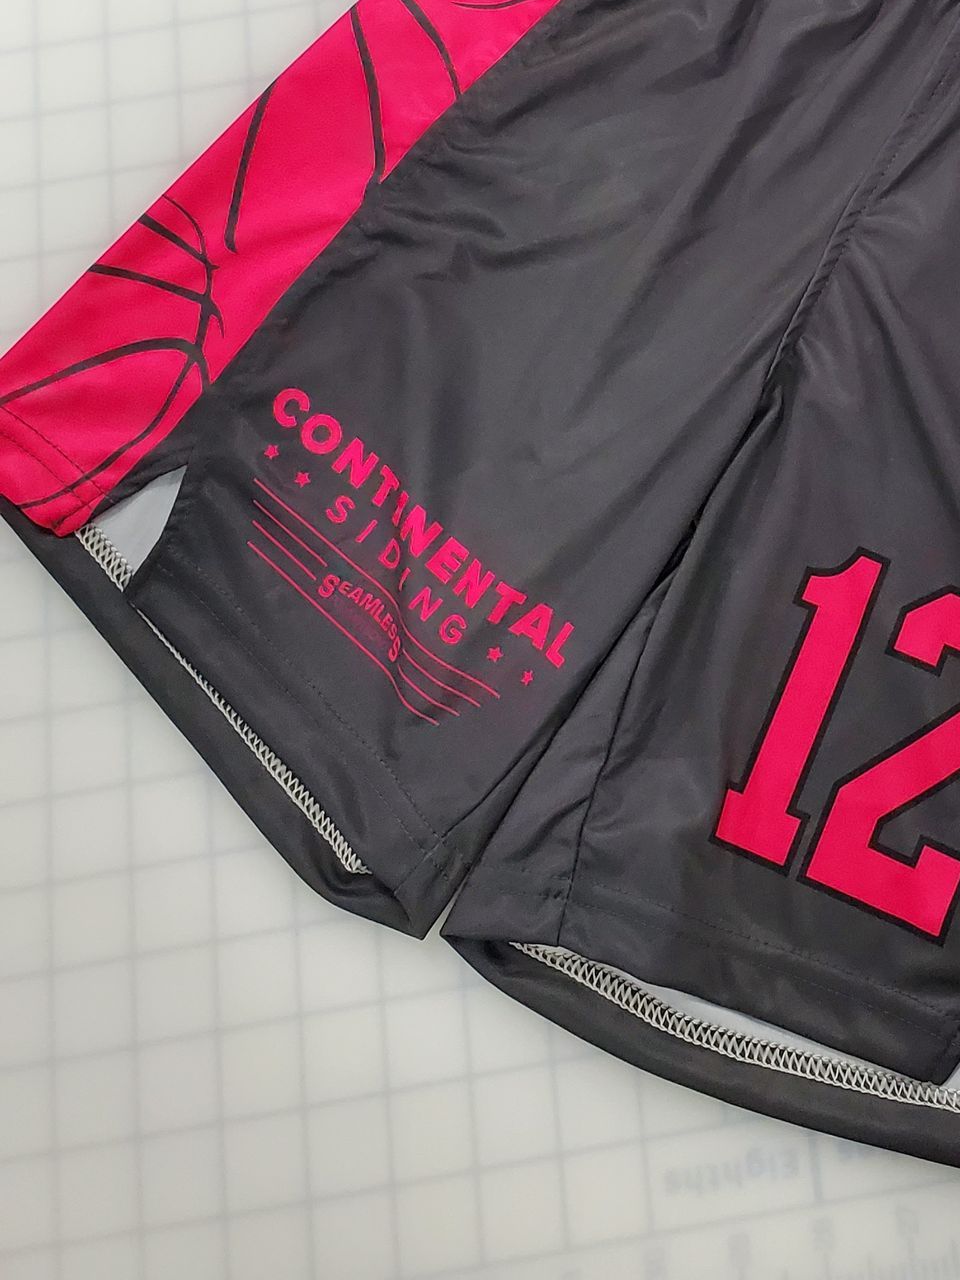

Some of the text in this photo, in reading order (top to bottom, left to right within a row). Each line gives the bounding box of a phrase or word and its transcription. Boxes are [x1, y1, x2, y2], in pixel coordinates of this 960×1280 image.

[272, 387, 575, 669] CONTINENTAL
[325, 495, 468, 645] SIDING
[318, 573, 400, 662] SEAMLESS
